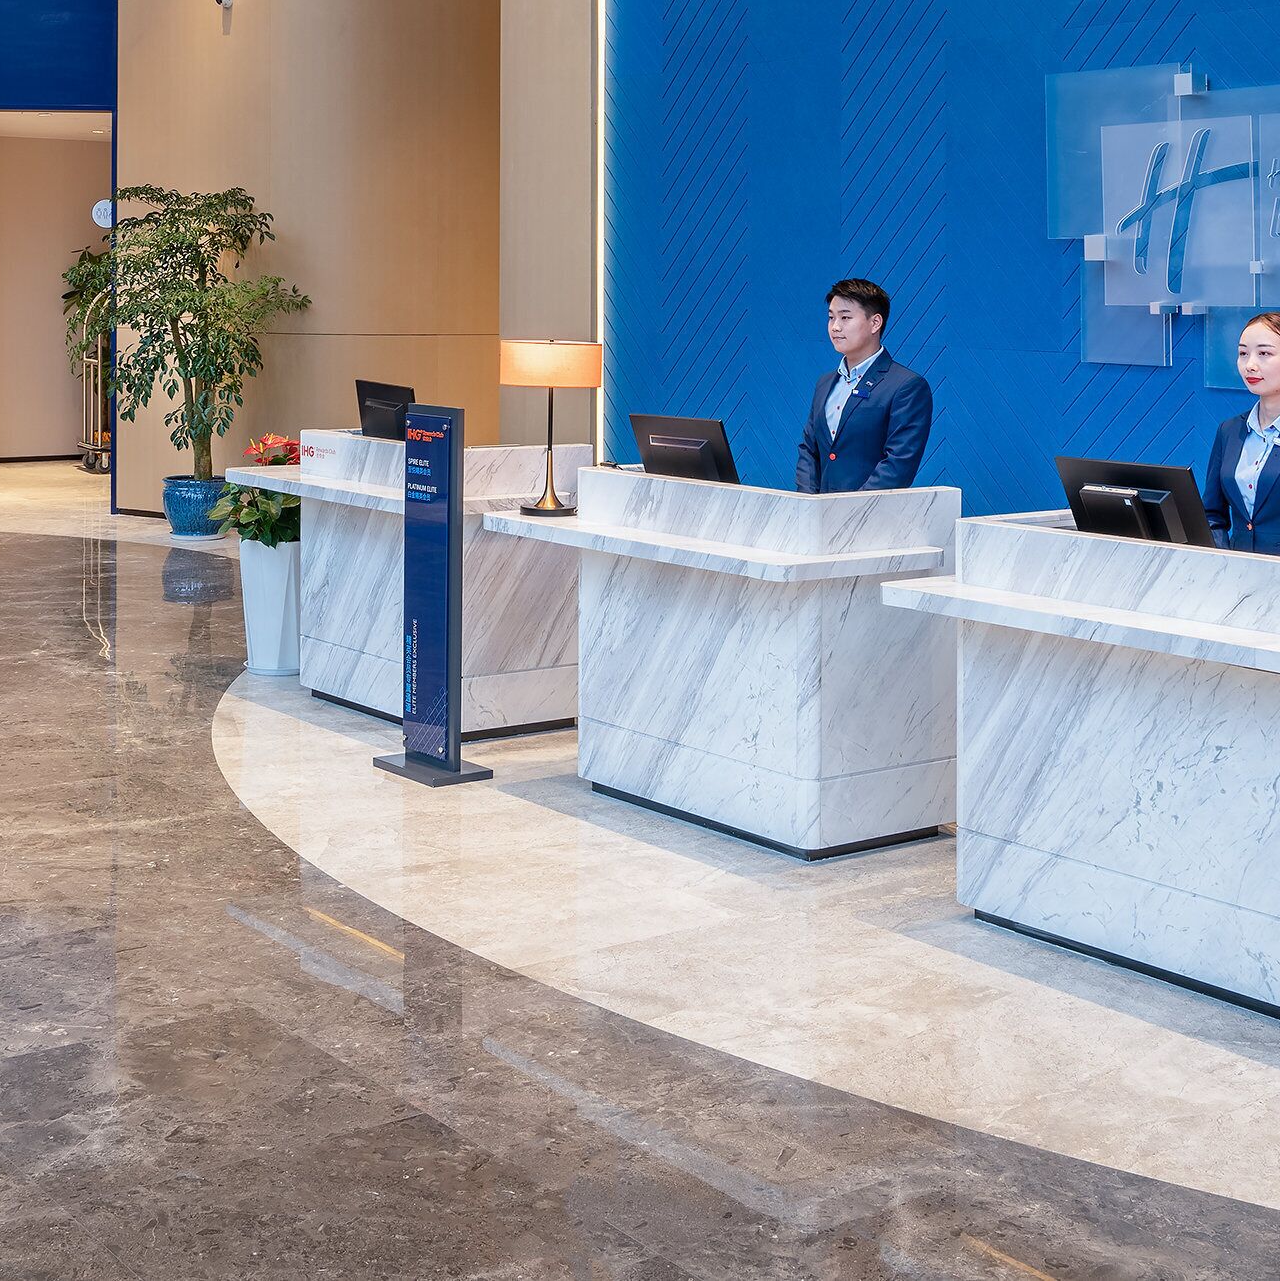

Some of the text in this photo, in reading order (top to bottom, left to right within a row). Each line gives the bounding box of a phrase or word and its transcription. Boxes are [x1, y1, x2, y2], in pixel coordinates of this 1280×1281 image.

[301, 445, 314, 457] IHG
[407, 458, 430, 467] SPIRE ELITE
[407, 482, 437, 493] PLATINUM ELITE
